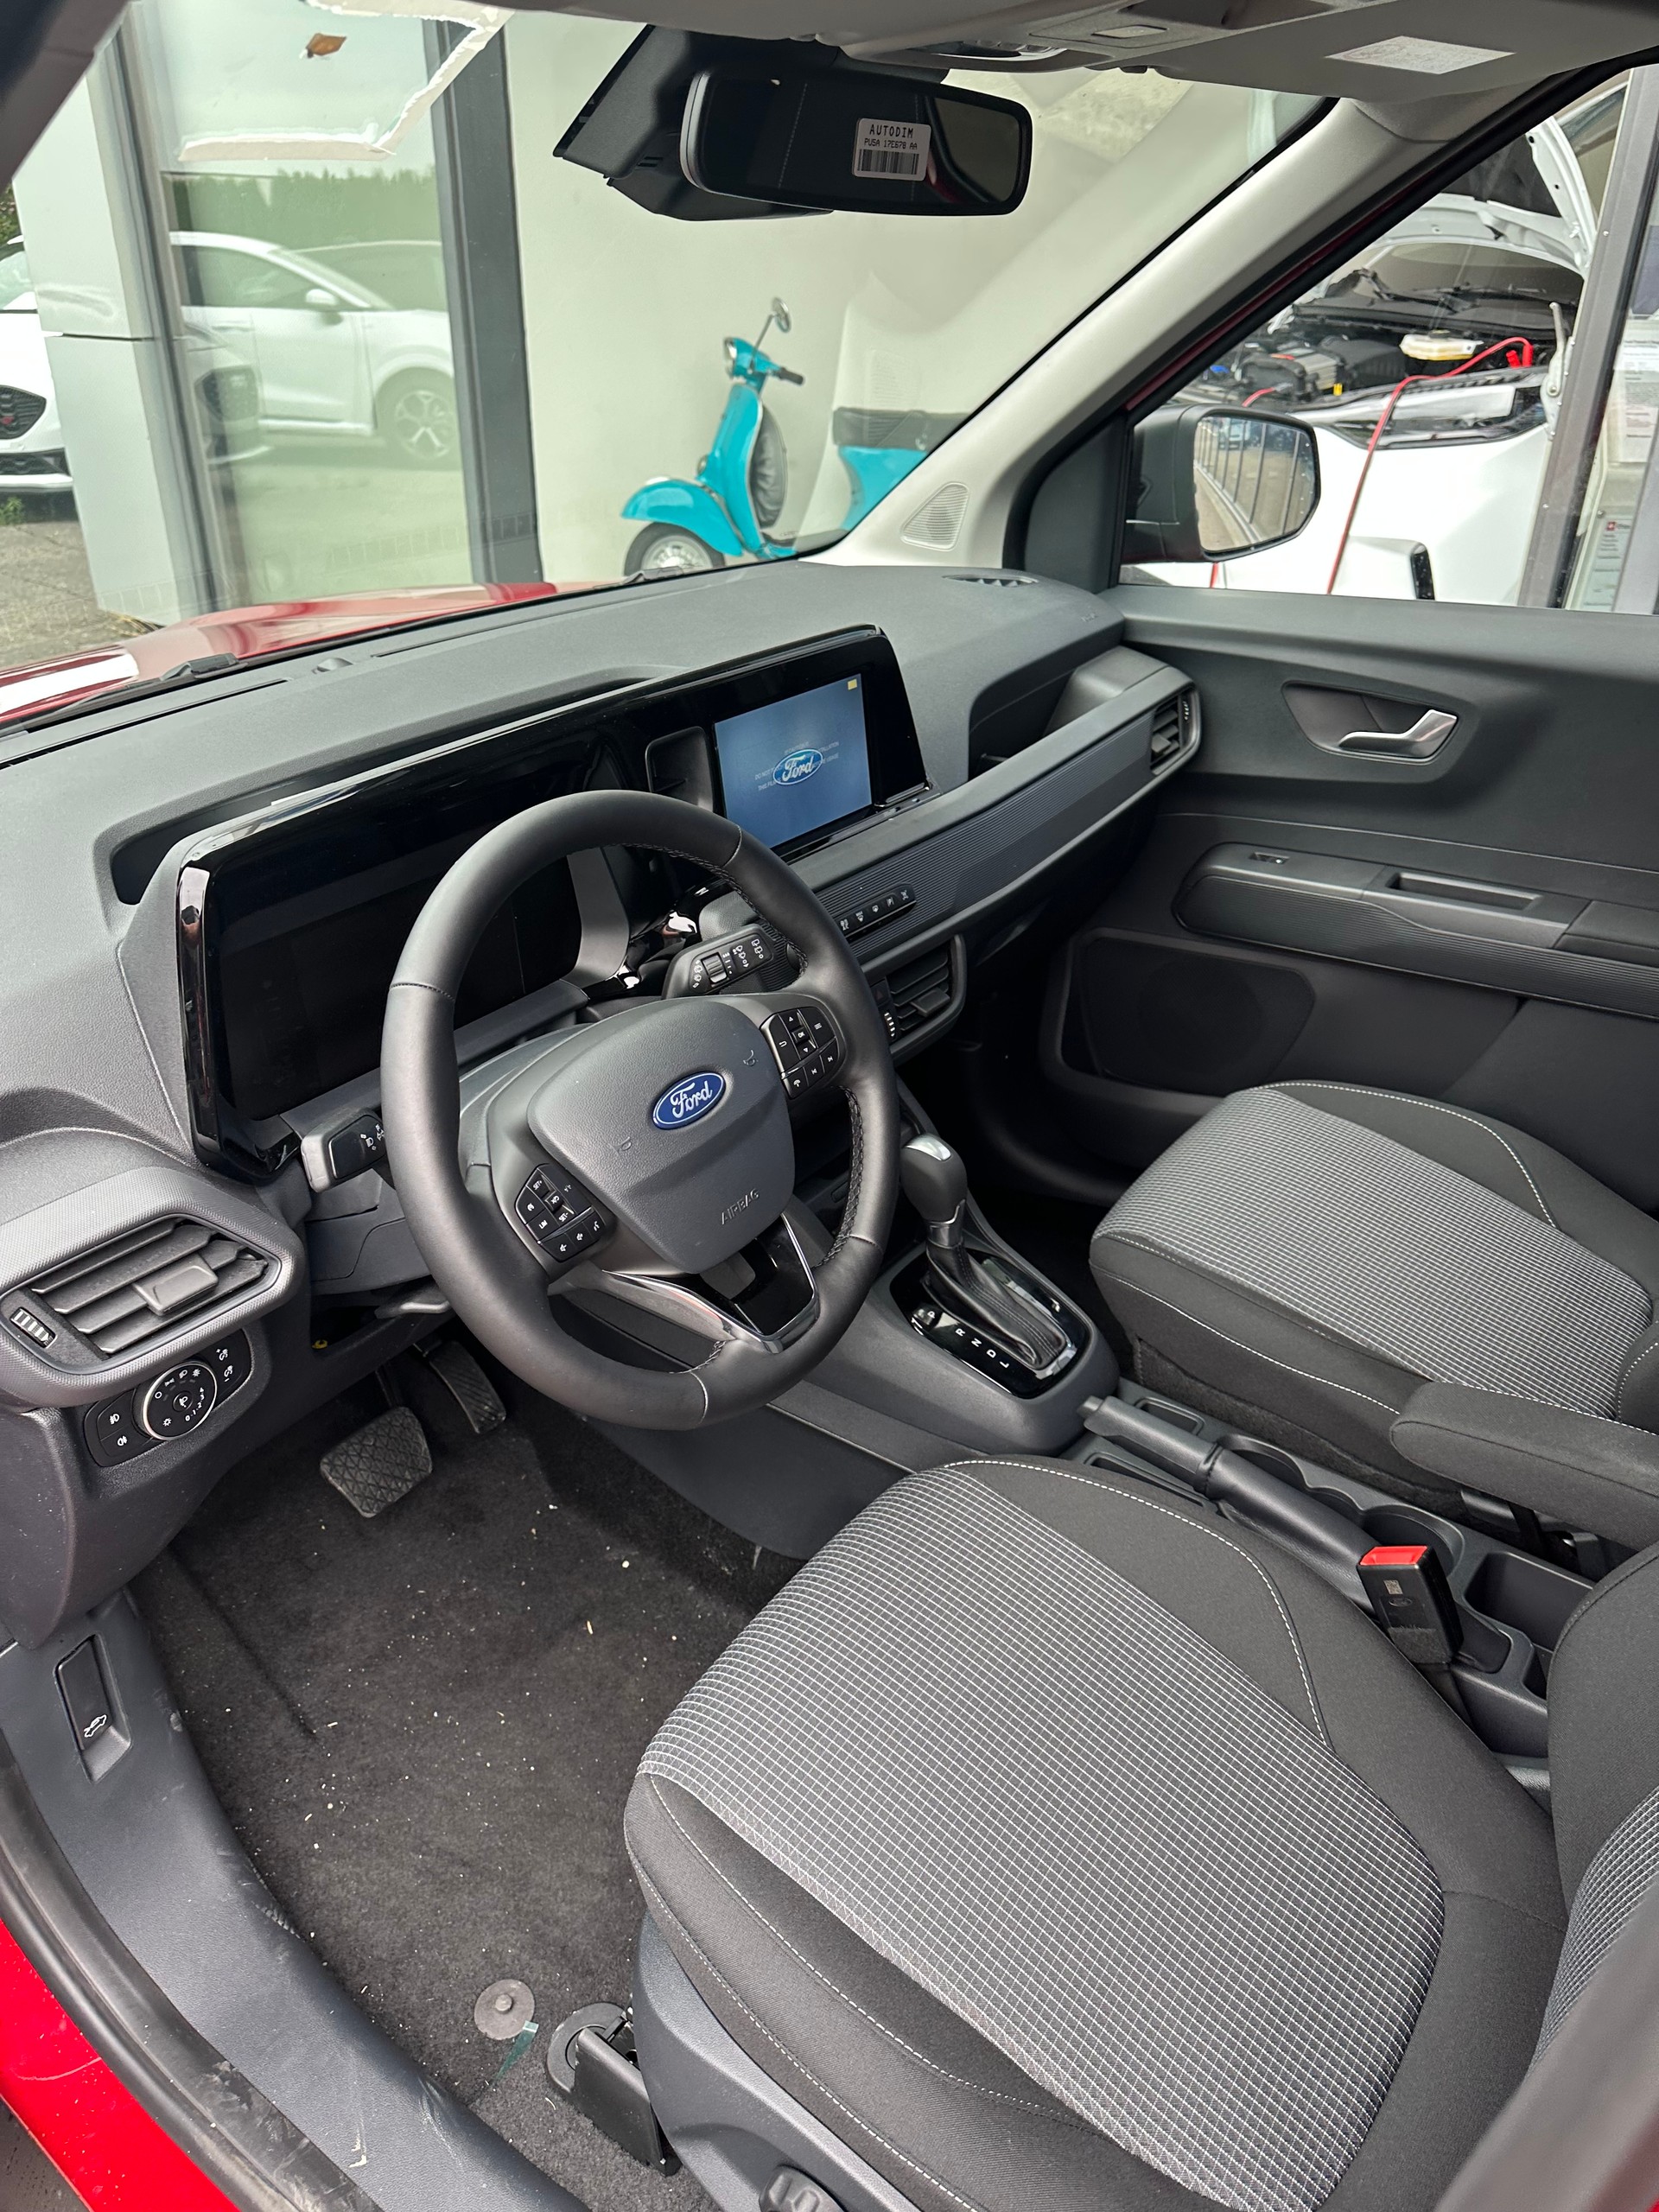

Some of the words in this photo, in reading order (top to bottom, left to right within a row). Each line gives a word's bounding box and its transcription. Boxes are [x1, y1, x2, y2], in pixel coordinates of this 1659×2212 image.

[869, 124, 913, 138] AUTODIM
[670, 1080, 713, 1118] Ford
[532, 1180, 543, 1191] SET+
[721, 1188, 760, 1225] AIRBAG
[538, 1219, 548, 1230] LIM
[955, 1328, 966, 1337] R
[971, 1338, 982, 1347] N
[986, 1349, 996, 1358] D
